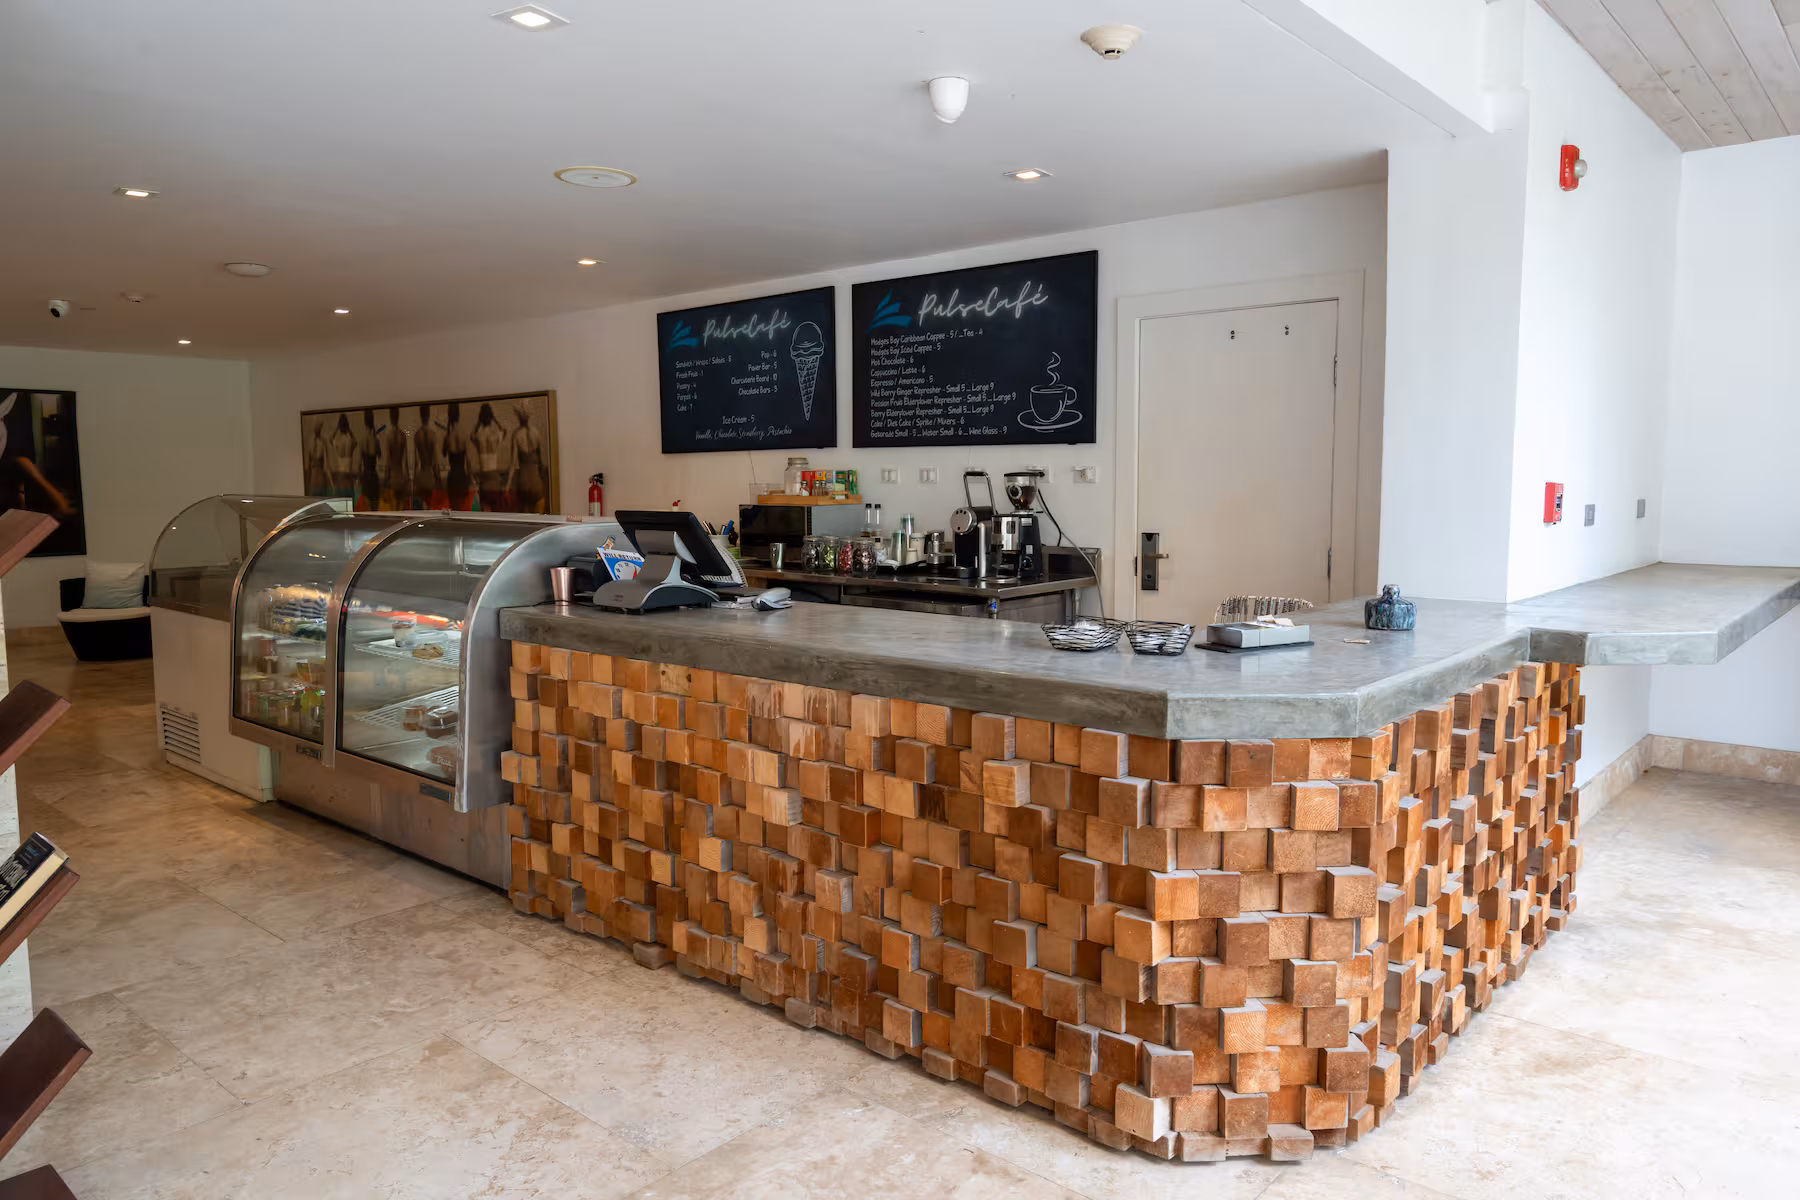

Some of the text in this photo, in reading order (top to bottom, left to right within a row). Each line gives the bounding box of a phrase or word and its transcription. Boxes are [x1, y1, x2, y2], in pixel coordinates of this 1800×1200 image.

[918, 281, 1048, 326] PulseCafé
[703, 309, 791, 347] PulseCafé
[890, 336, 900, 347] Bay
[890, 347, 900, 357] Bay
[871, 368, 897, 377] Cappuccino
[871, 379, 894, 388] Espresso
[898, 377, 925, 385] Americano
[738, 387, 759, 396] Chocolate
[760, 386, 771, 394] Bars
[881, 388, 895, 398] Berry
[897, 387, 913, 398] Ginger
[946, 384, 960, 393] Small
[972, 384, 989, 394] Large
[990, 382, 994, 390] 9
[967, 394, 981, 403] Small
[993, 392, 1011, 404] Large
[1012, 392, 1016, 400] 9
[871, 410, 885, 420] Berry
[948, 405, 962, 414] Small
[972, 405, 989, 416] Large
[990, 404, 994, 412] 9
[722, 416, 730, 424] Ice
[916, 418, 932, 427] Sprite
[870, 430, 894, 438] Gatorade
[895, 429, 908, 437] Small
[922, 429, 938, 437] Water
[940, 427, 953, 436] Small
[982, 426, 998, 434] Glass
